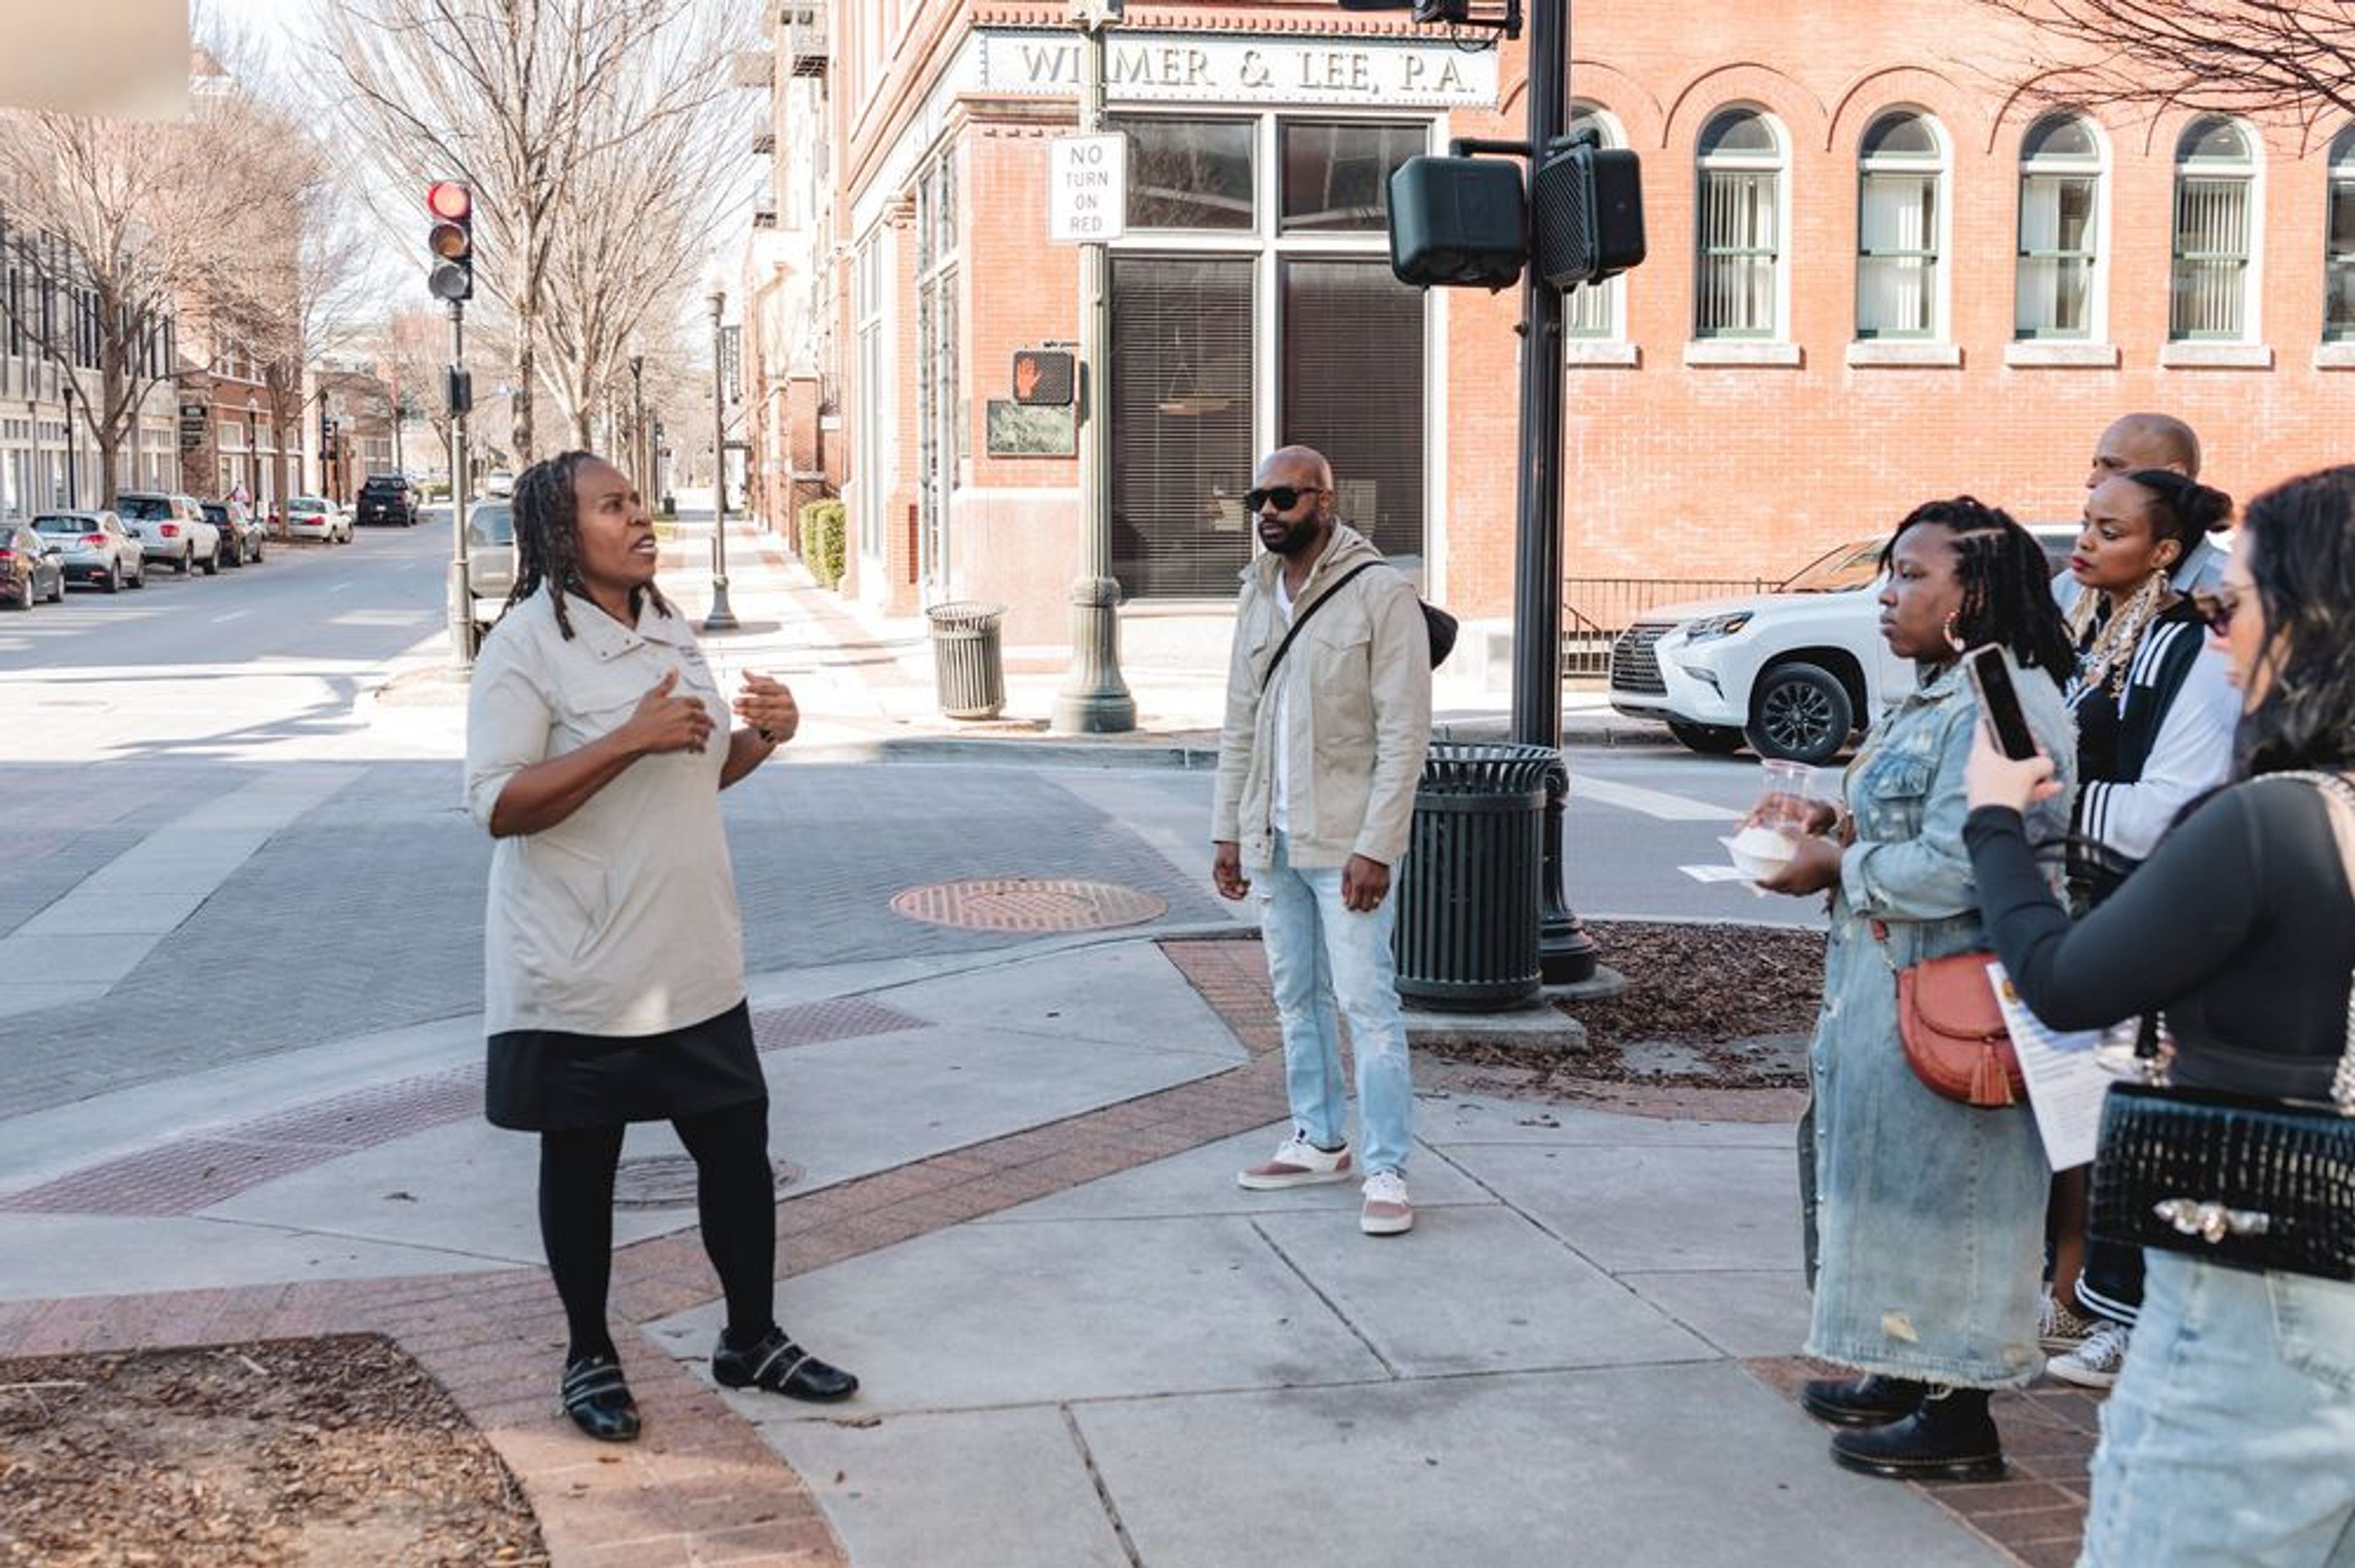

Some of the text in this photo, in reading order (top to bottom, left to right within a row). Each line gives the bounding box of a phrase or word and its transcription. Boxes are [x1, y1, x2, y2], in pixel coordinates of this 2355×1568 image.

[1015, 44, 1476, 94] WIMER & LEE, P.A.
[1071, 145, 1103, 164] NO
[1066, 172, 1108, 187] TURN
[1074, 193, 1097, 210] ON
[1071, 216, 1103, 232] RED
